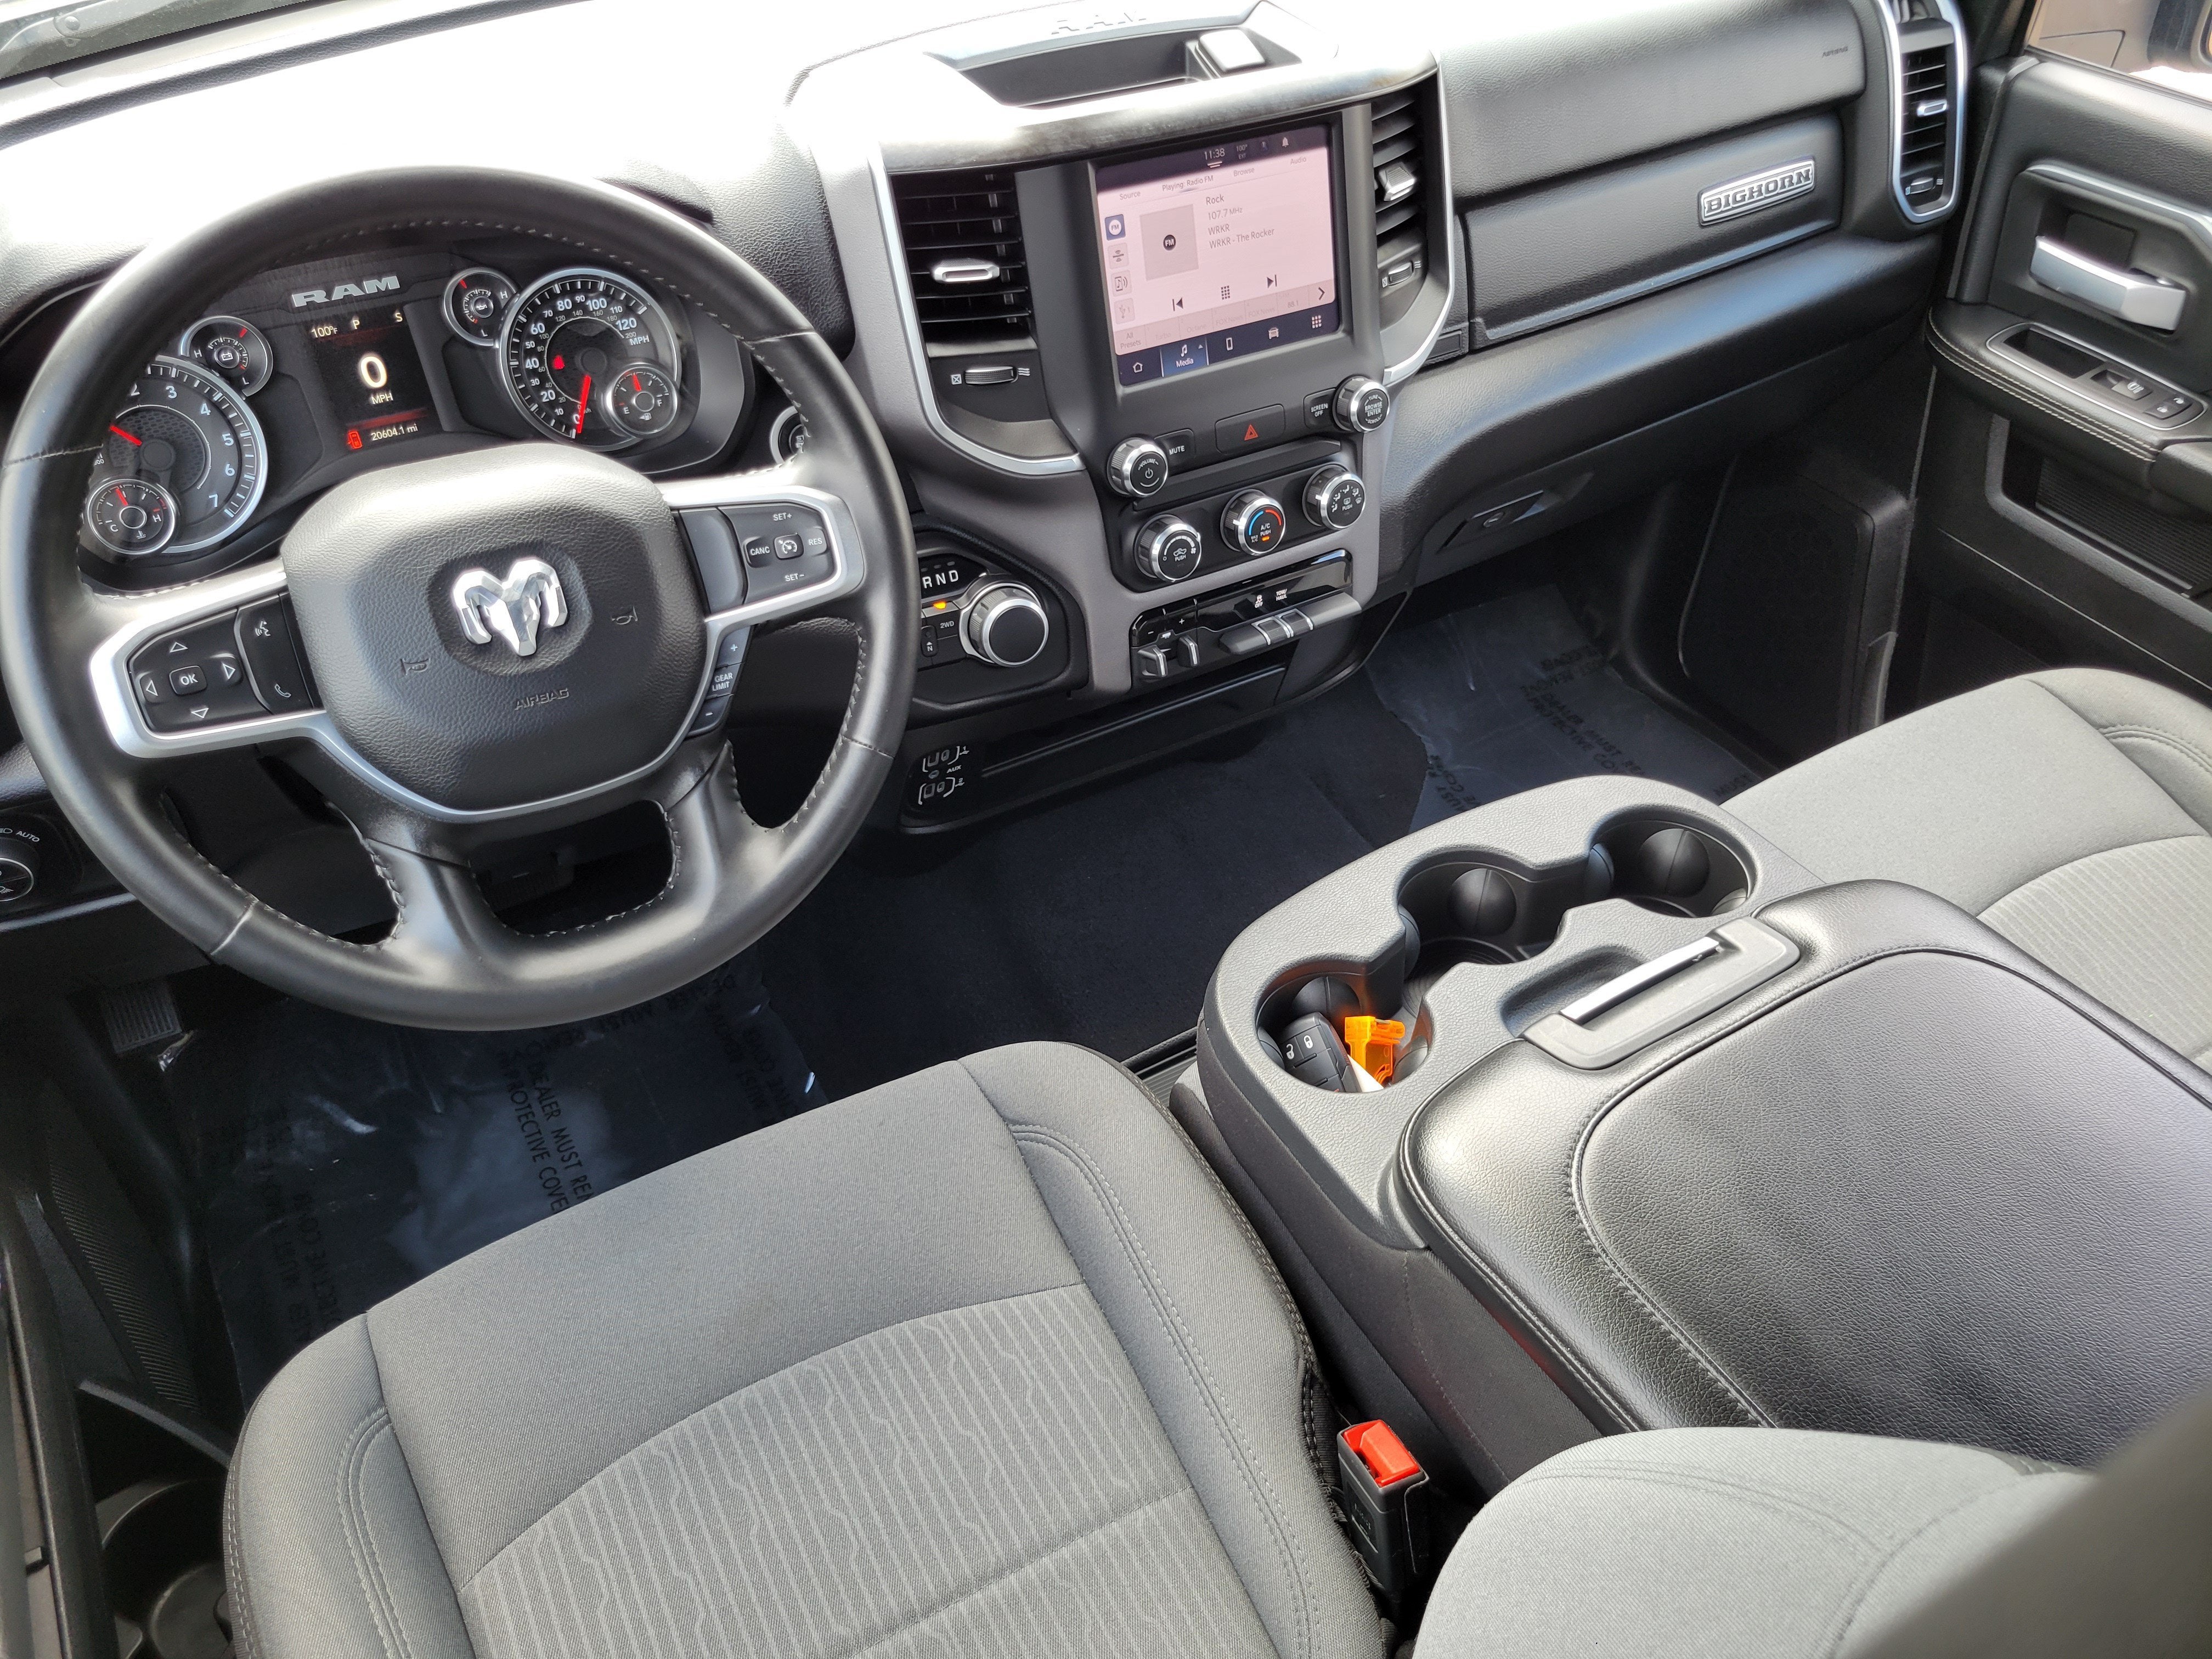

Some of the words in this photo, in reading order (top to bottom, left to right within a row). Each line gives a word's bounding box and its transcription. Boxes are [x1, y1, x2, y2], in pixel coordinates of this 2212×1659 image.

[1204, 148, 1226, 160] 11:38
[1290, 156, 1307, 165] Audio
[1233, 167, 1255, 177] Browse
[1187, 177, 1204, 187] Radio
[1204, 174, 1214, 183] FM
[1119, 190, 1141, 200] Source
[1705, 167, 1812, 216] BIGHORN
[1206, 194, 1224, 205] Rock
[1208, 208, 1228, 220] 107.7
[1208, 223, 1230, 235] WRKR
[1165, 238, 1175, 247] FM
[1209, 237, 1231, 249] WRKR
[1237, 234, 1250, 242] The
[1251, 228, 1275, 240] Rocker
[291, 275, 400, 307] RAM
[500, 290, 508, 299] H
[556, 298, 573, 311] 80
[575, 295, 586, 303] 90
[586, 297, 608, 311] 100
[543, 309, 554, 318] 70
[610, 306, 623, 314] 110
[394, 312, 403, 323] S
[352, 319, 360, 330] P
[530, 322, 545, 335] 60
[615, 317, 637, 331] 120
[524, 341, 535, 349] 50
[629, 335, 650, 346] MPH
[1120, 340, 1141, 349] Presets
[194, 349, 202, 358] H
[525, 358, 539, 370] 40
[1176, 357, 1194, 368] Media
[360, 355, 388, 388] 0
[242, 376, 250, 385] L
[529, 379, 540, 387] 30
[166, 385, 178, 399] 3
[539, 389, 556, 403] 20
[370, 392, 394, 405] MPH
[200, 403, 211, 416] 4
[623, 407, 630, 415] E
[1311, 403, 1329, 413] SCREEN
[1364, 401, 1383, 411] BROWSE
[554, 408, 564, 416] 10
[1367, 408, 1381, 417] ENTER
[371, 426, 405, 441] 20604.1
[407, 423, 418, 433] mi
[222, 432, 234, 447] 5
[1169, 445, 1186, 455] MUTE
[1139, 458, 1156, 468] VOLUME
[225, 464, 235, 477] 6
[208, 493, 218, 508] 7
[152, 514, 162, 523] H
[110, 524, 119, 532] C
[1260, 522, 1271, 531] A/C
[1260, 529, 1271, 537] PUSH
[808, 538, 823, 546] RES
[749, 545, 770, 556] CANC
[922, 575, 933, 589] R
[935, 572, 946, 586] N
[948, 569, 959, 583] D
[1276, 588, 1288, 596] TOW/
[940, 620, 955, 629] 2WD
[180, 673, 199, 686] OK
[714, 672, 733, 683] GEAR
[713, 681, 730, 691] LIMIT
[514, 688, 570, 710] AIRBAG
[946, 764, 962, 774] AUX
[16, 830, 40, 842] AUTO
[503, 1069, 550, 1164] PROTECTIVE
[526, 1060, 561, 1122] DEALER
[550, 1126, 583, 1172] MUST
